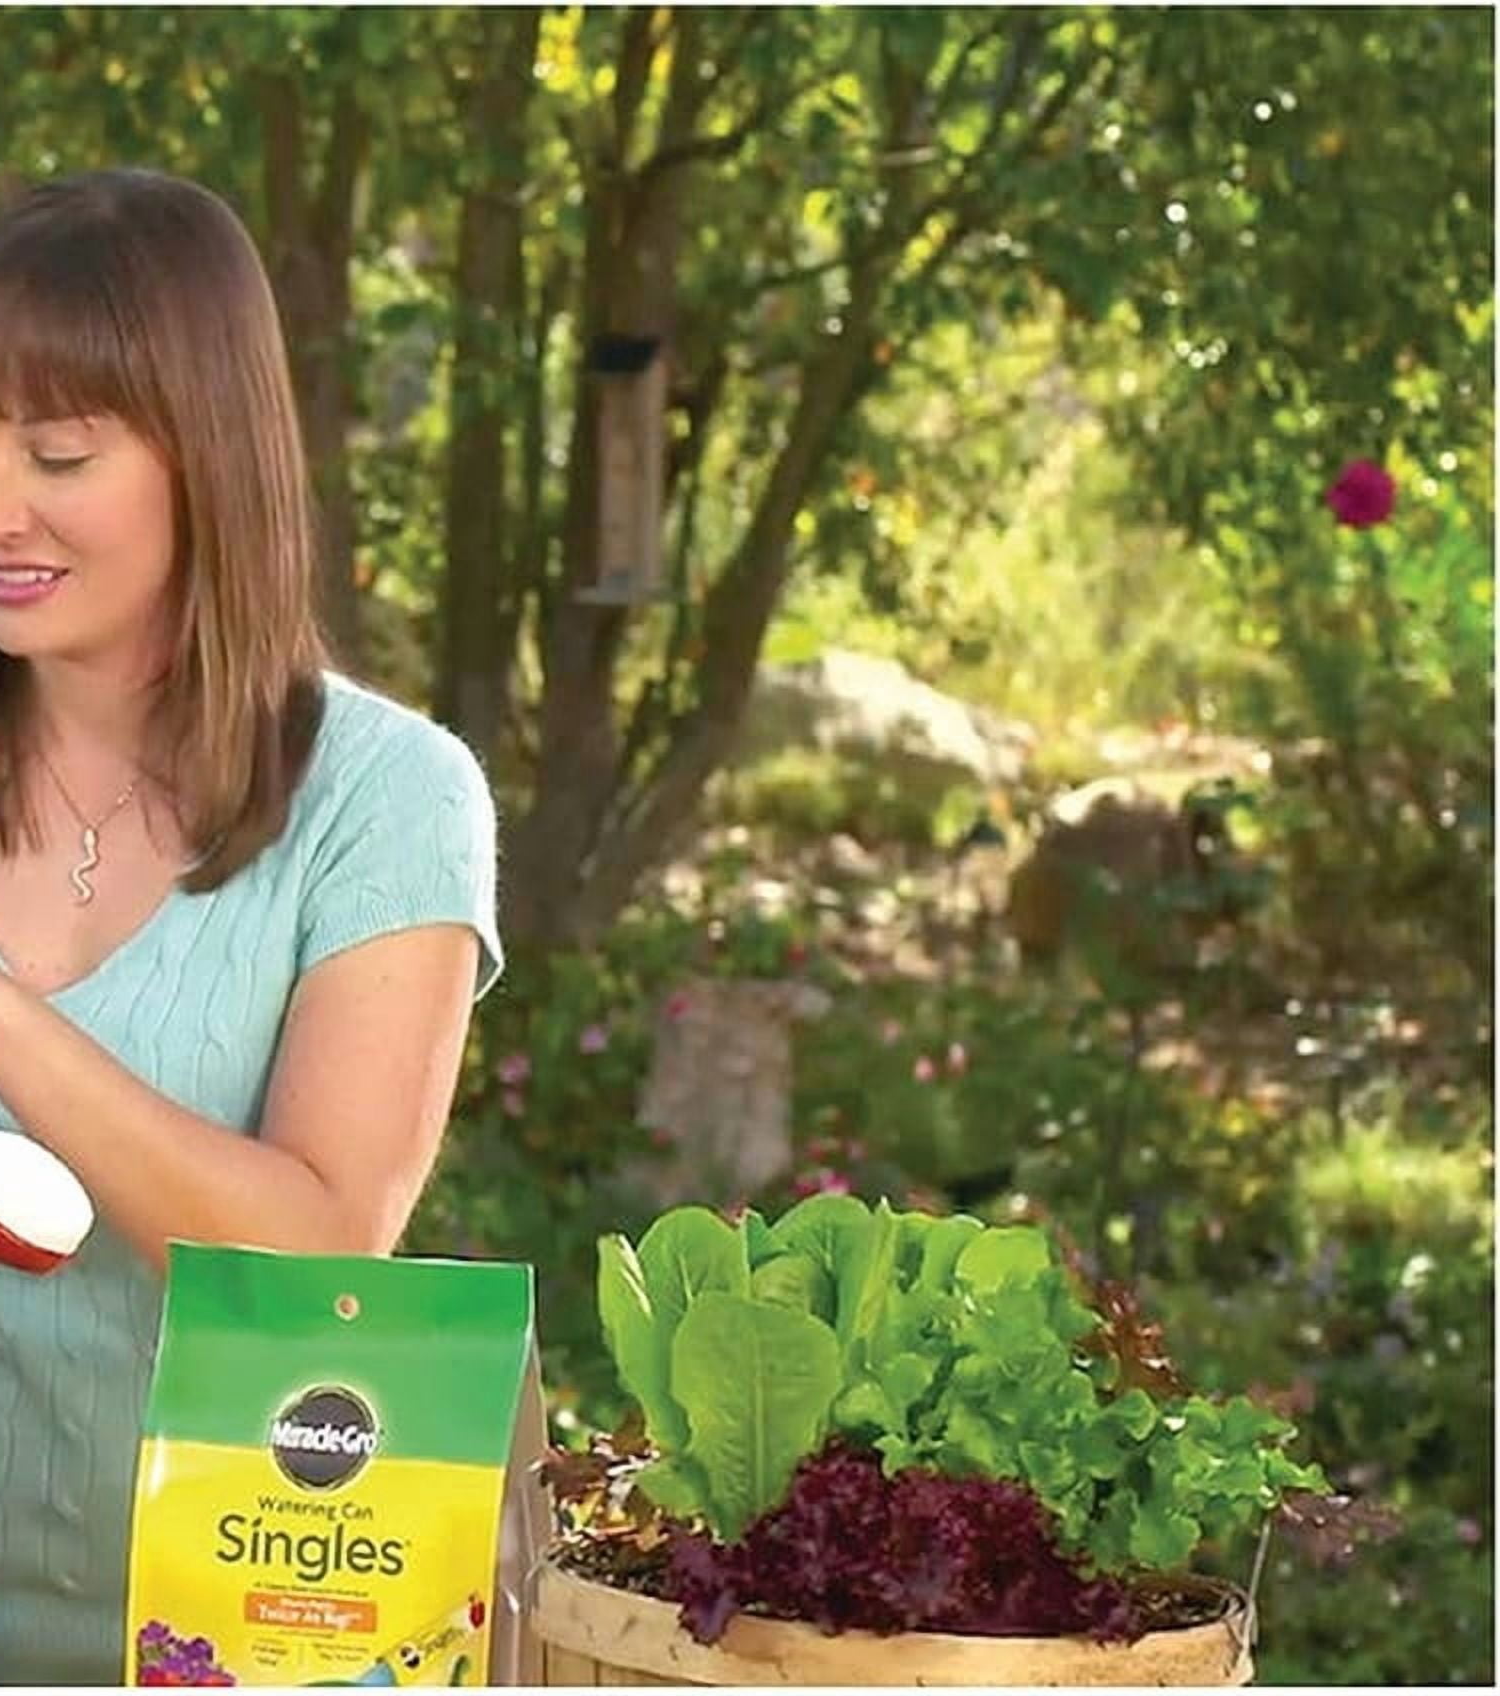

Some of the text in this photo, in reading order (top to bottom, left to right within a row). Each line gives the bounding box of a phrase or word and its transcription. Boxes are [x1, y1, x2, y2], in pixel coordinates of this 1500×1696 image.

[258, 1496, 374, 1521] Watering Can
[216, 1513, 405, 1582] Singles
